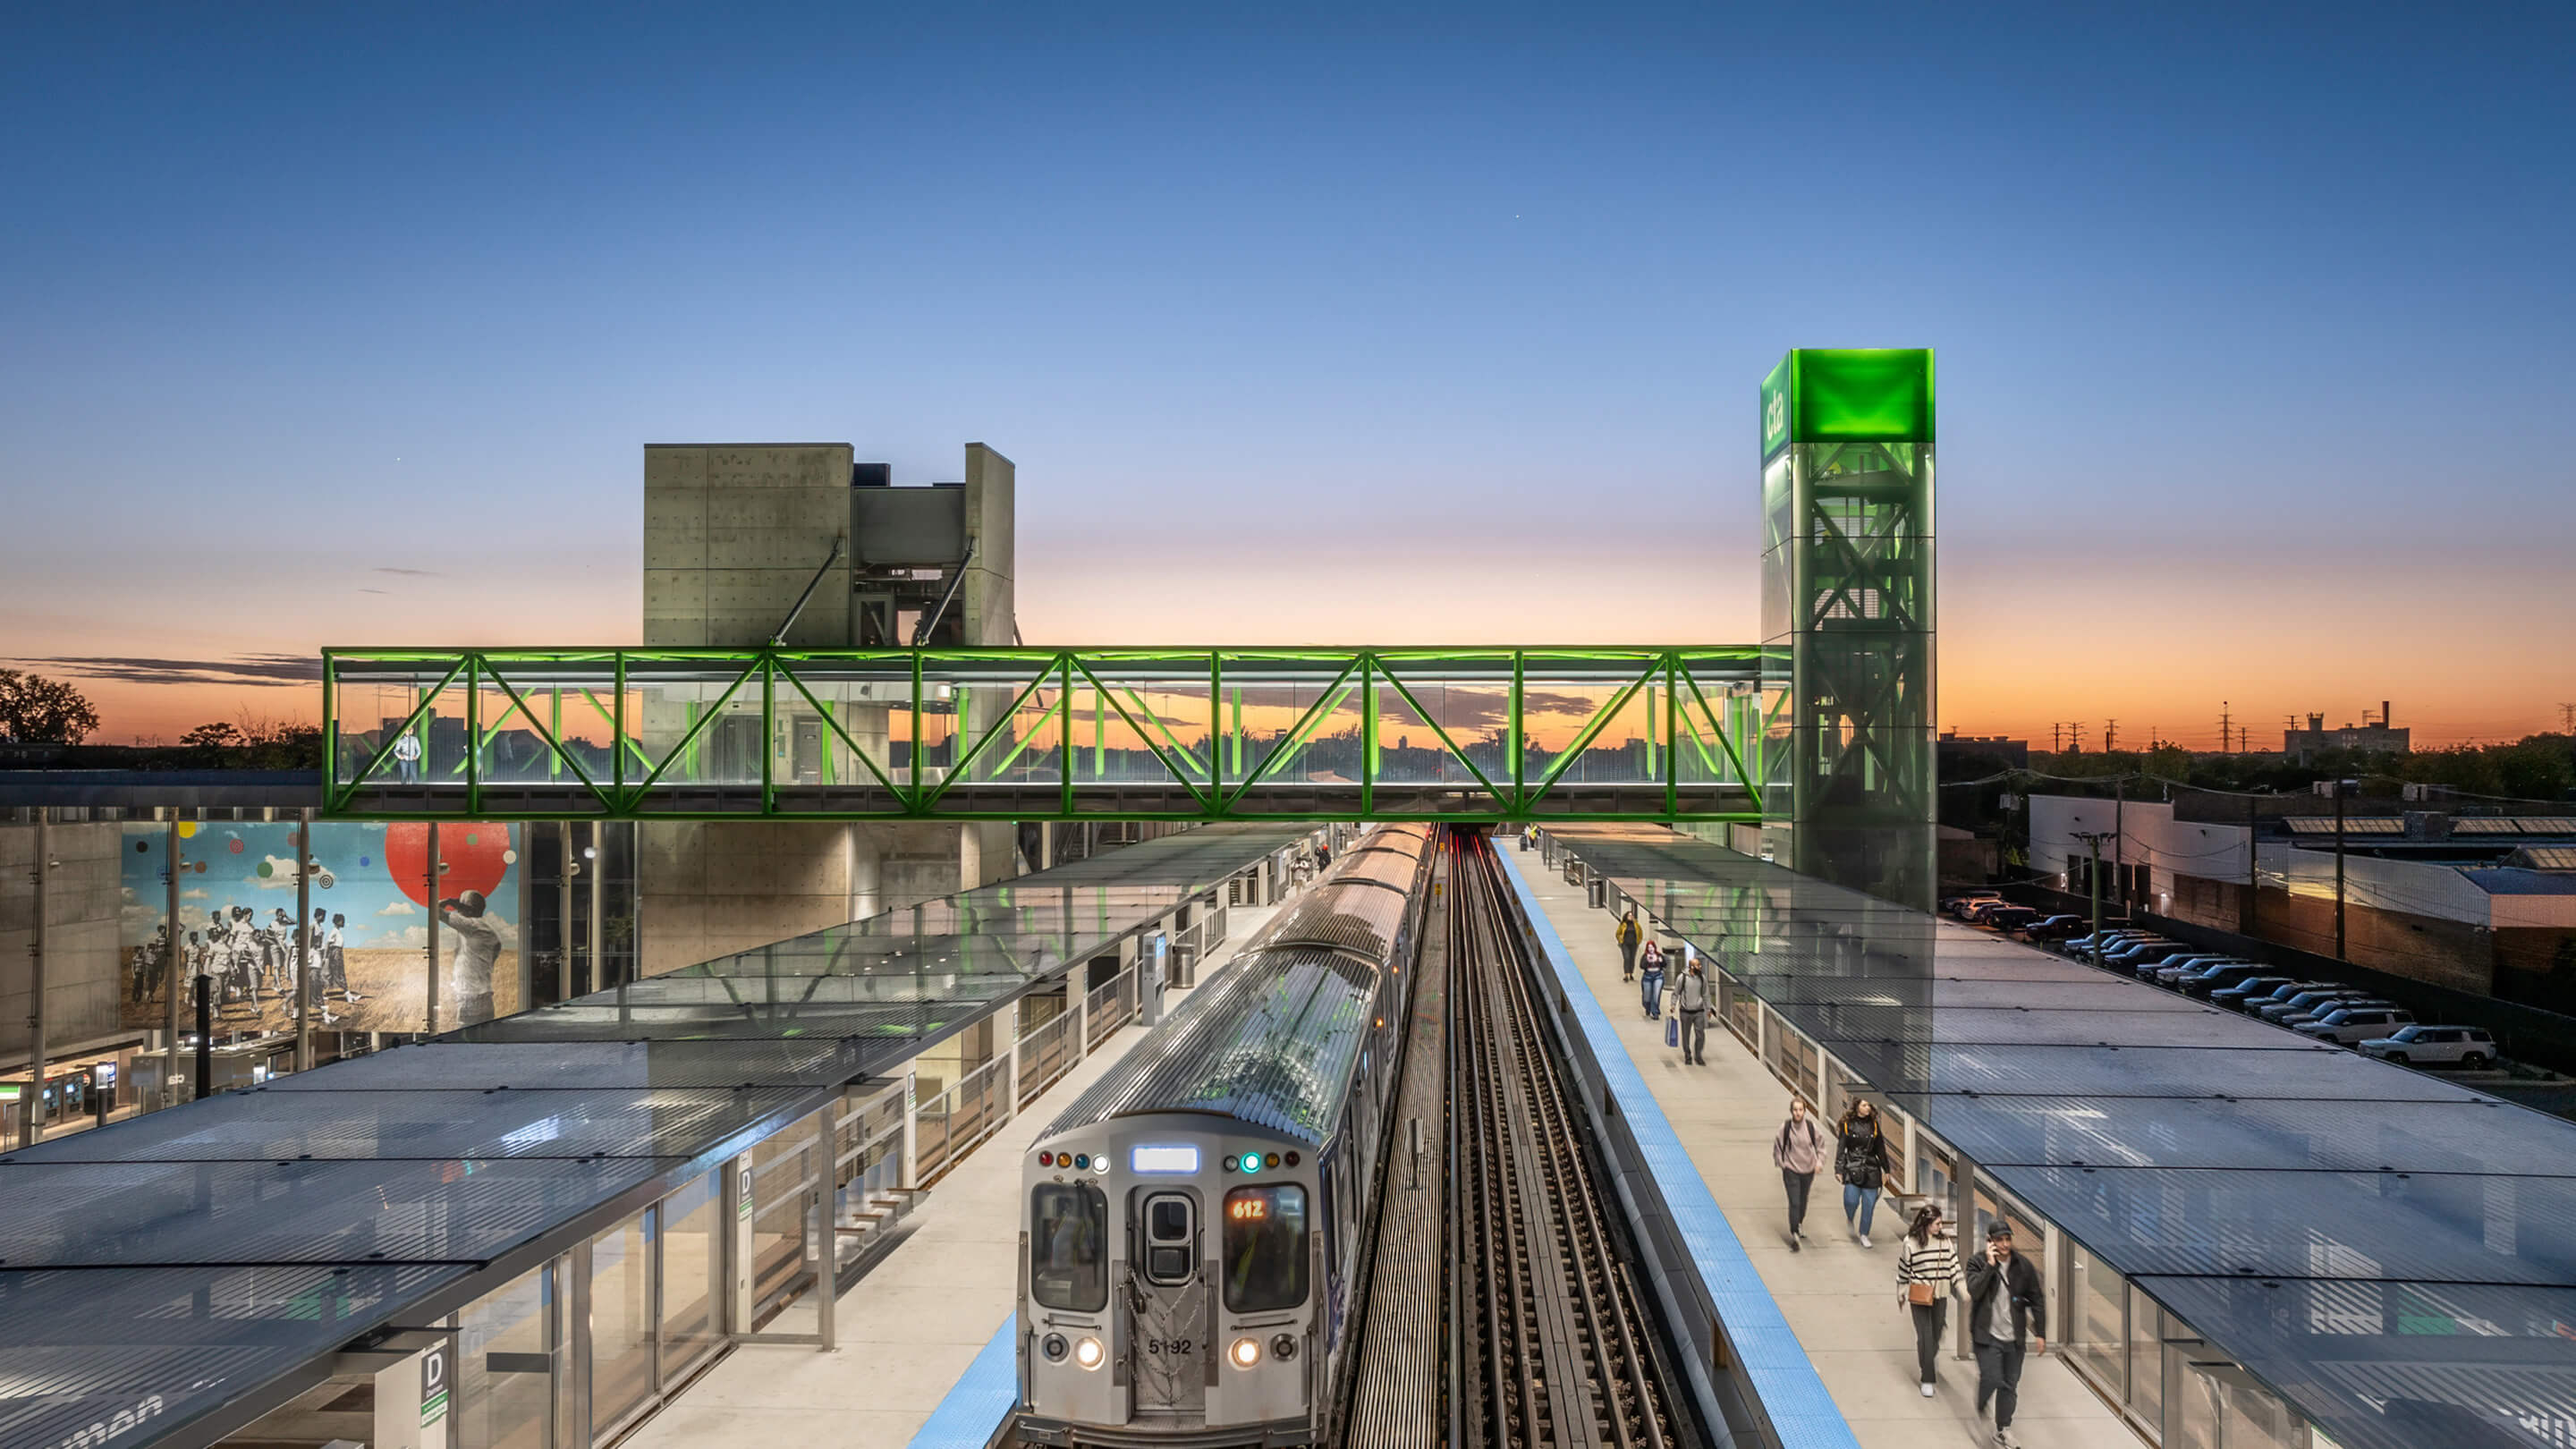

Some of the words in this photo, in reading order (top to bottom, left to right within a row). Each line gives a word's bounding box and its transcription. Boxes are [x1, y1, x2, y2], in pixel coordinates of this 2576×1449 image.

[1767, 388, 1784, 442] cta
[741, 1170, 750, 1195] D
[1233, 1199, 1264, 1219] 612
[1148, 1338, 1191, 1354] 5192
[427, 1352, 443, 1387] D
